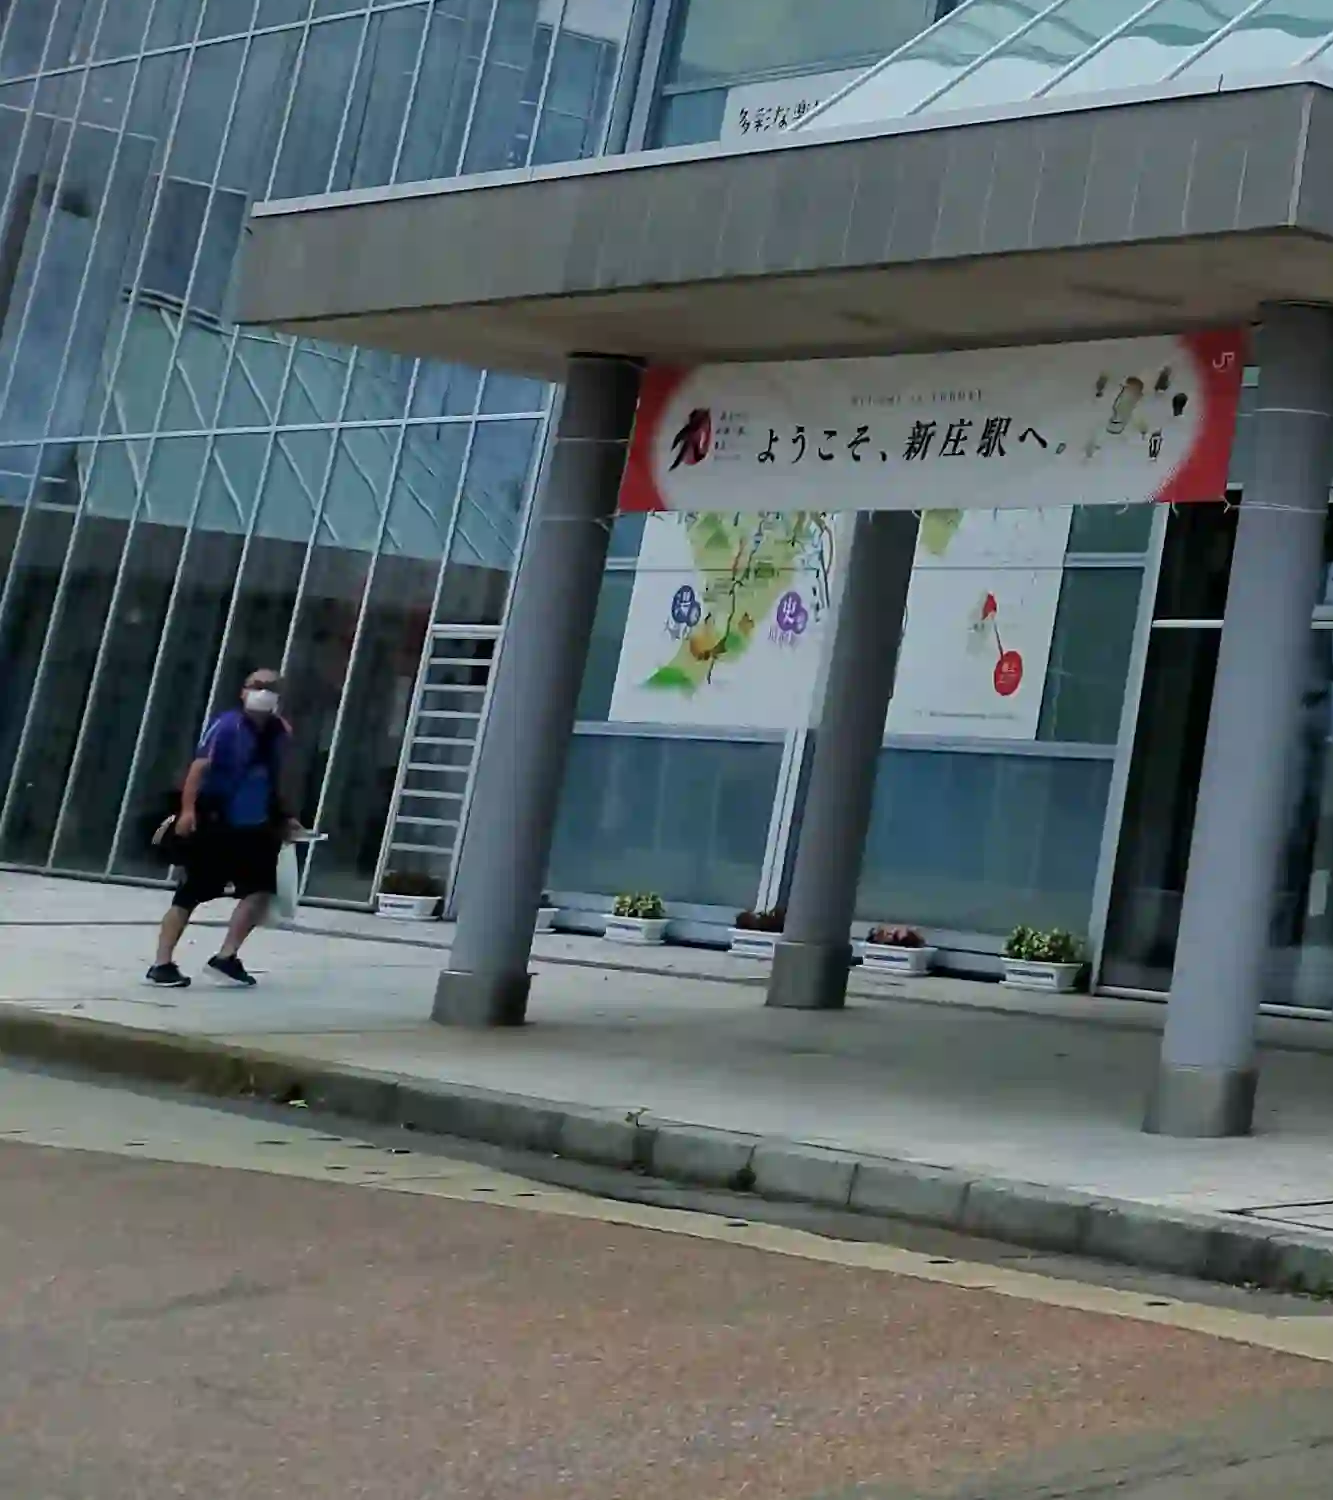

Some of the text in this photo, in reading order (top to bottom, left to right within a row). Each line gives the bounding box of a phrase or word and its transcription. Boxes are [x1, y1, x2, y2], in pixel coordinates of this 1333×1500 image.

[1212, 351, 1235, 369] JR
[756, 416, 1067, 465] ようこそ、新庄駅へ。
